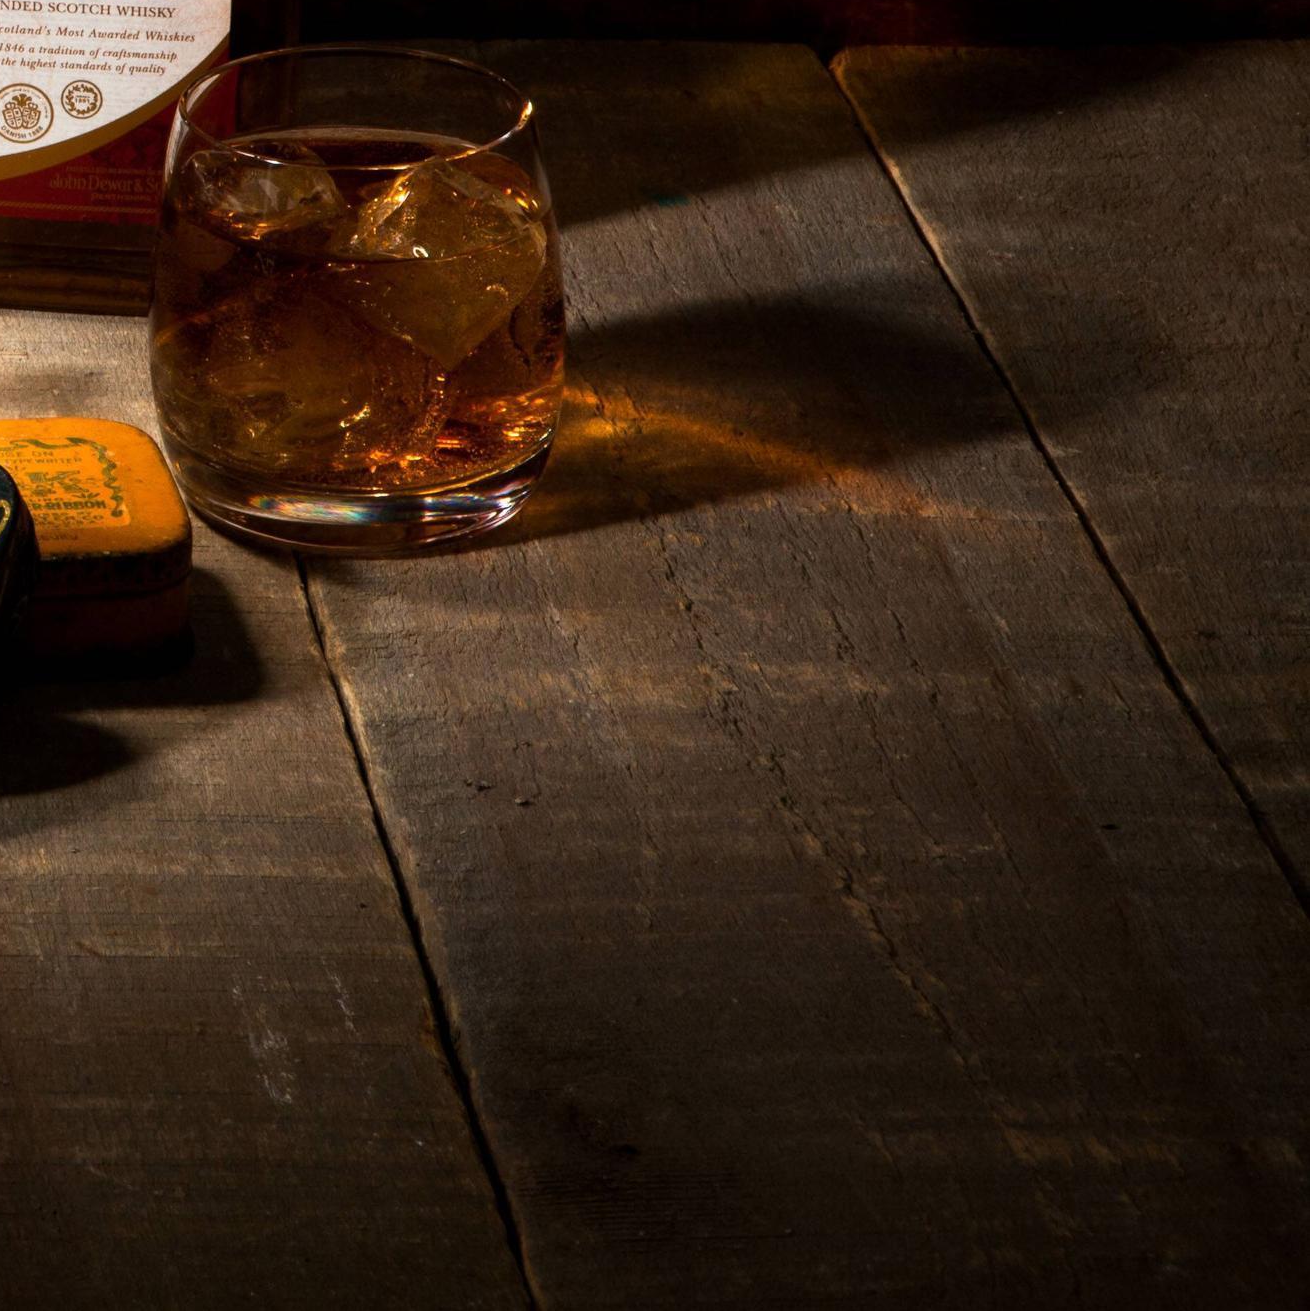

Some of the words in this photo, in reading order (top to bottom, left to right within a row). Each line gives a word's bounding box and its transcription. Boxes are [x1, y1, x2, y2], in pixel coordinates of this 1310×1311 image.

[47, 1, 113, 17] SCOTCH
[116, 5, 178, 20] WHISKY
[56, 26, 85, 38] Most
[89, 28, 141, 41] Awarded
[145, 30, 197, 44] Whiskies
[28, 46, 36, 54] a
[38, 44, 86, 57] tradition
[89, 46, 101, 59] of
[102, 48, 179, 63] craftsmanship
[0, 56, 17, 67] the
[19, 57, 57, 71] highest
[60, 60, 112, 72] standards
[115, 63, 127, 75] of
[128, 63, 167, 76] quality
[1, 124, 27, 140] DANISH
